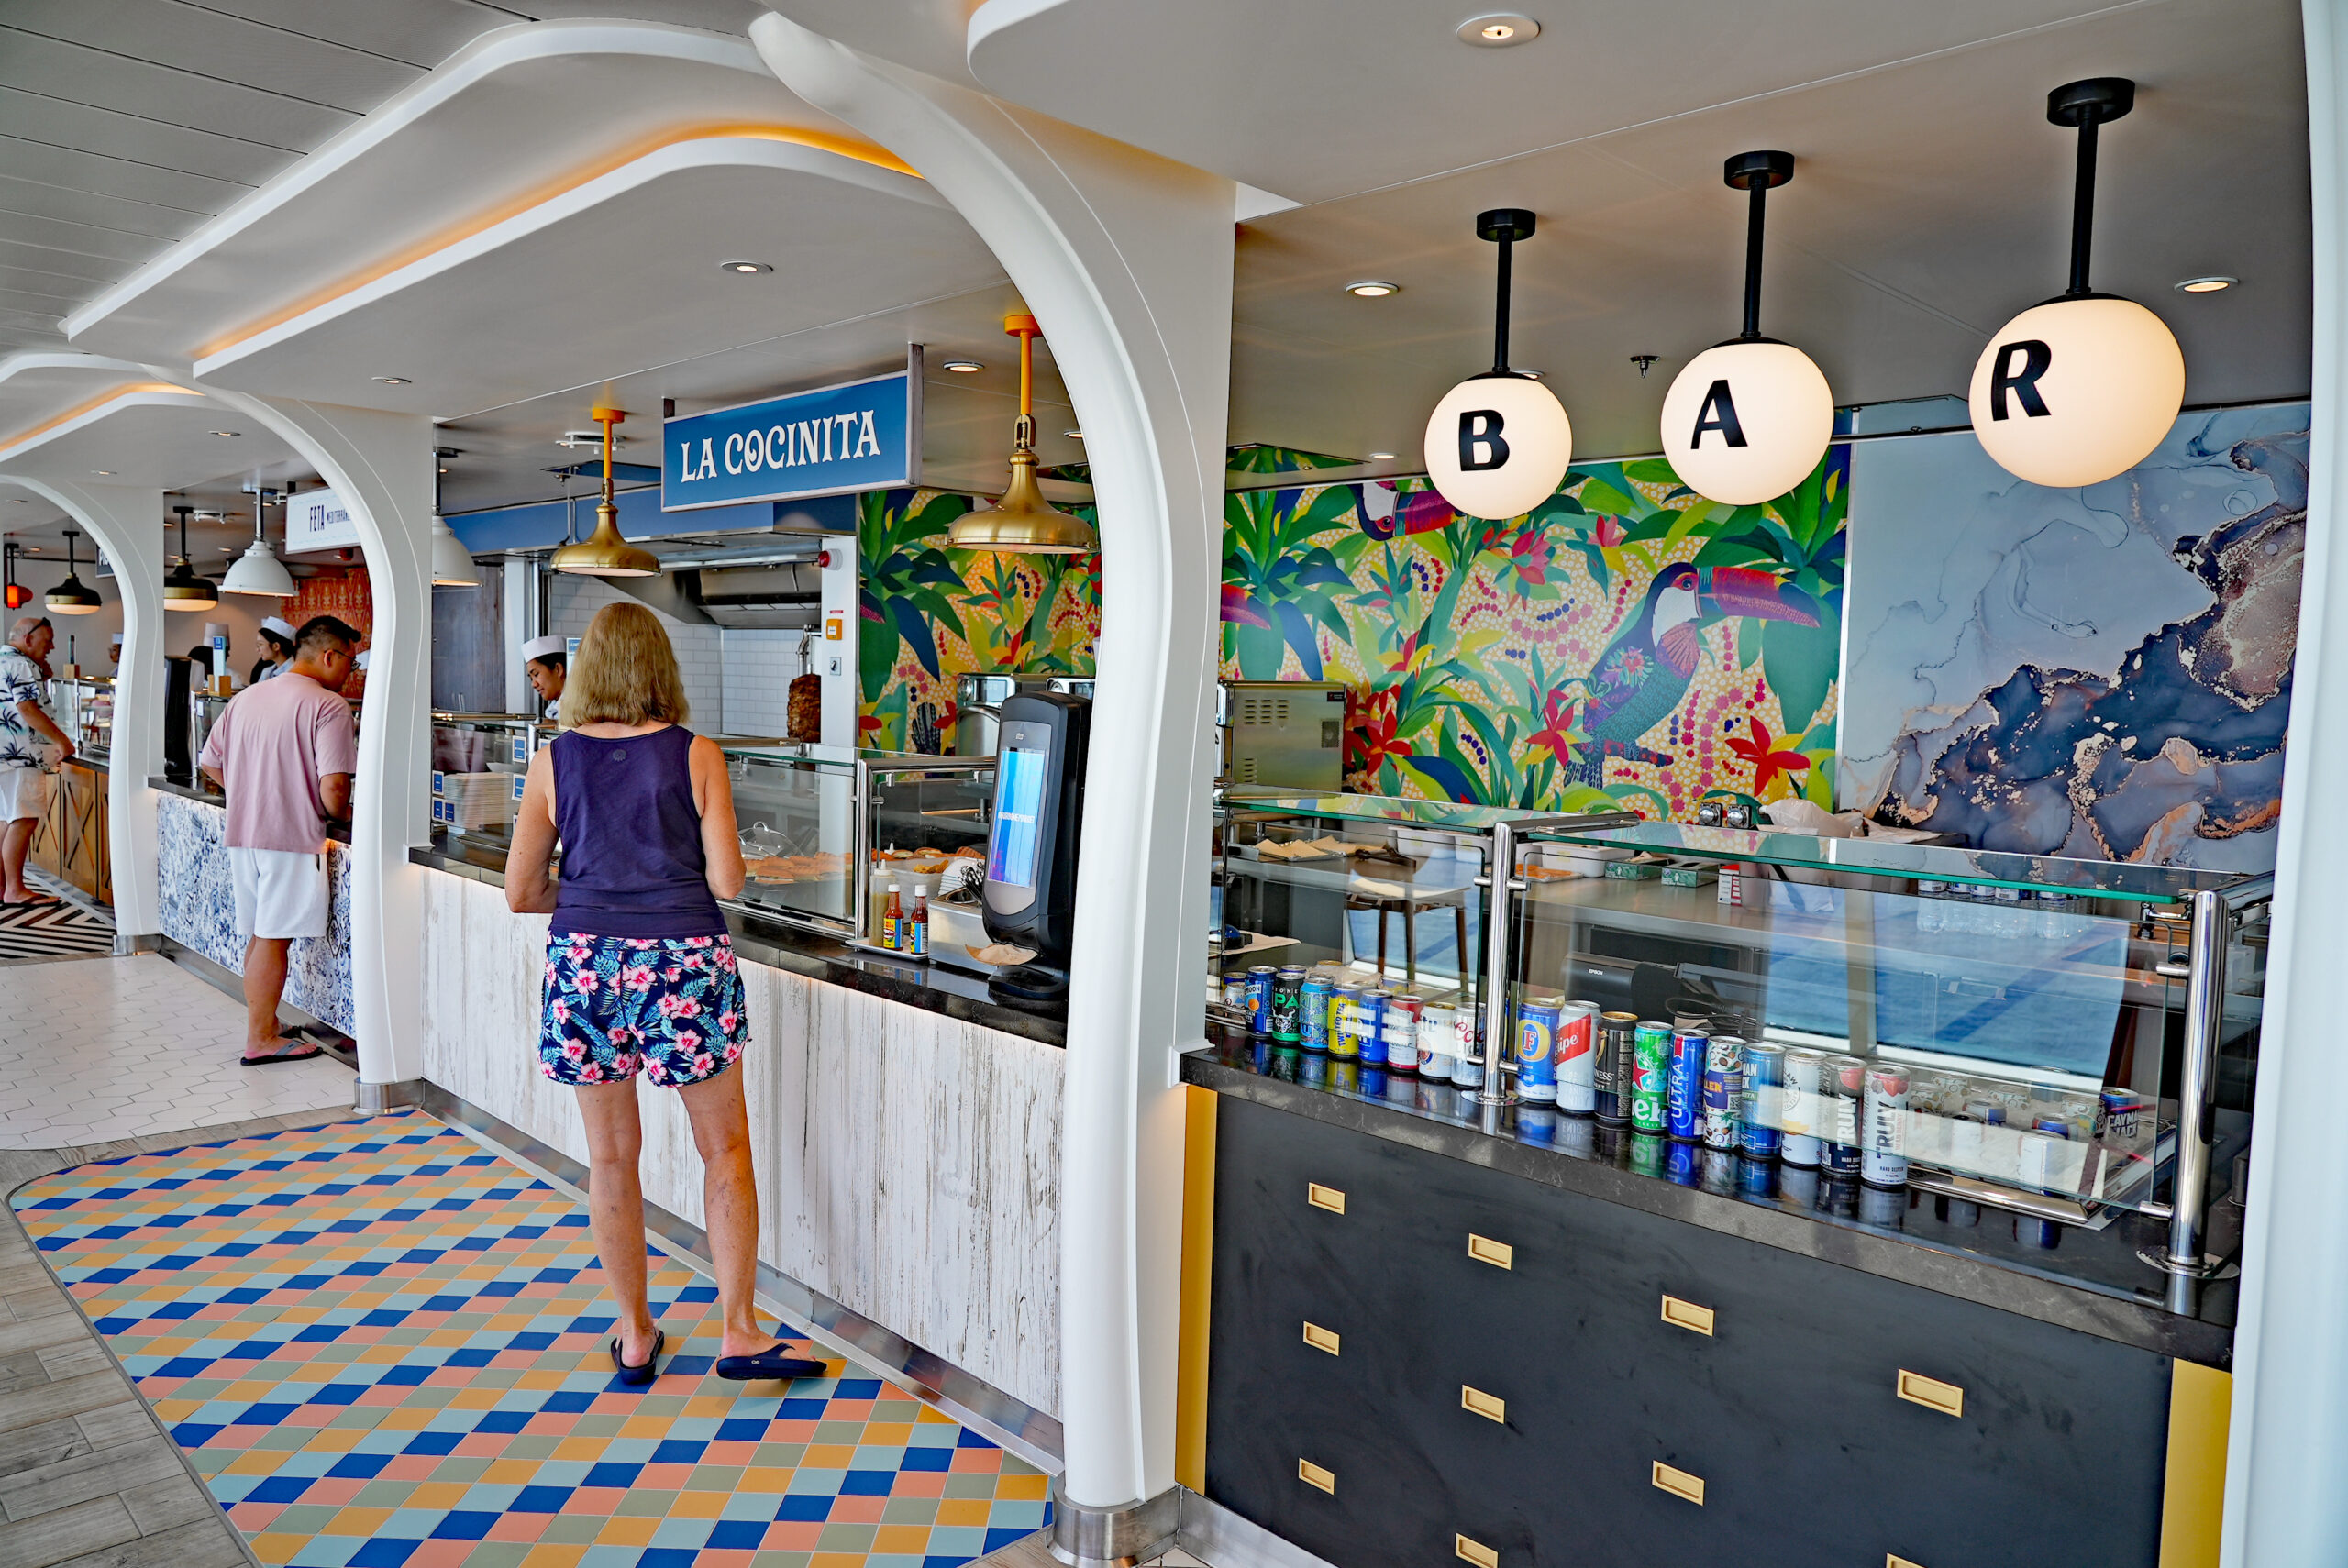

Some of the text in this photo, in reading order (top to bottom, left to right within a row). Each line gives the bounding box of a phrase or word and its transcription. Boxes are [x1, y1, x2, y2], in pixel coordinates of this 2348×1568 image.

[681, 409, 880, 483] LA COCINITA
[309, 504, 325, 532] FETA
[1595, 1068, 1612, 1081] NESS
[1671, 1063, 1684, 1119] ULTRA
[1837, 1092, 1857, 1151] TRULY
[1876, 1100, 1897, 1159] TRULY
[2107, 1110, 2138, 1126] CAYMA
